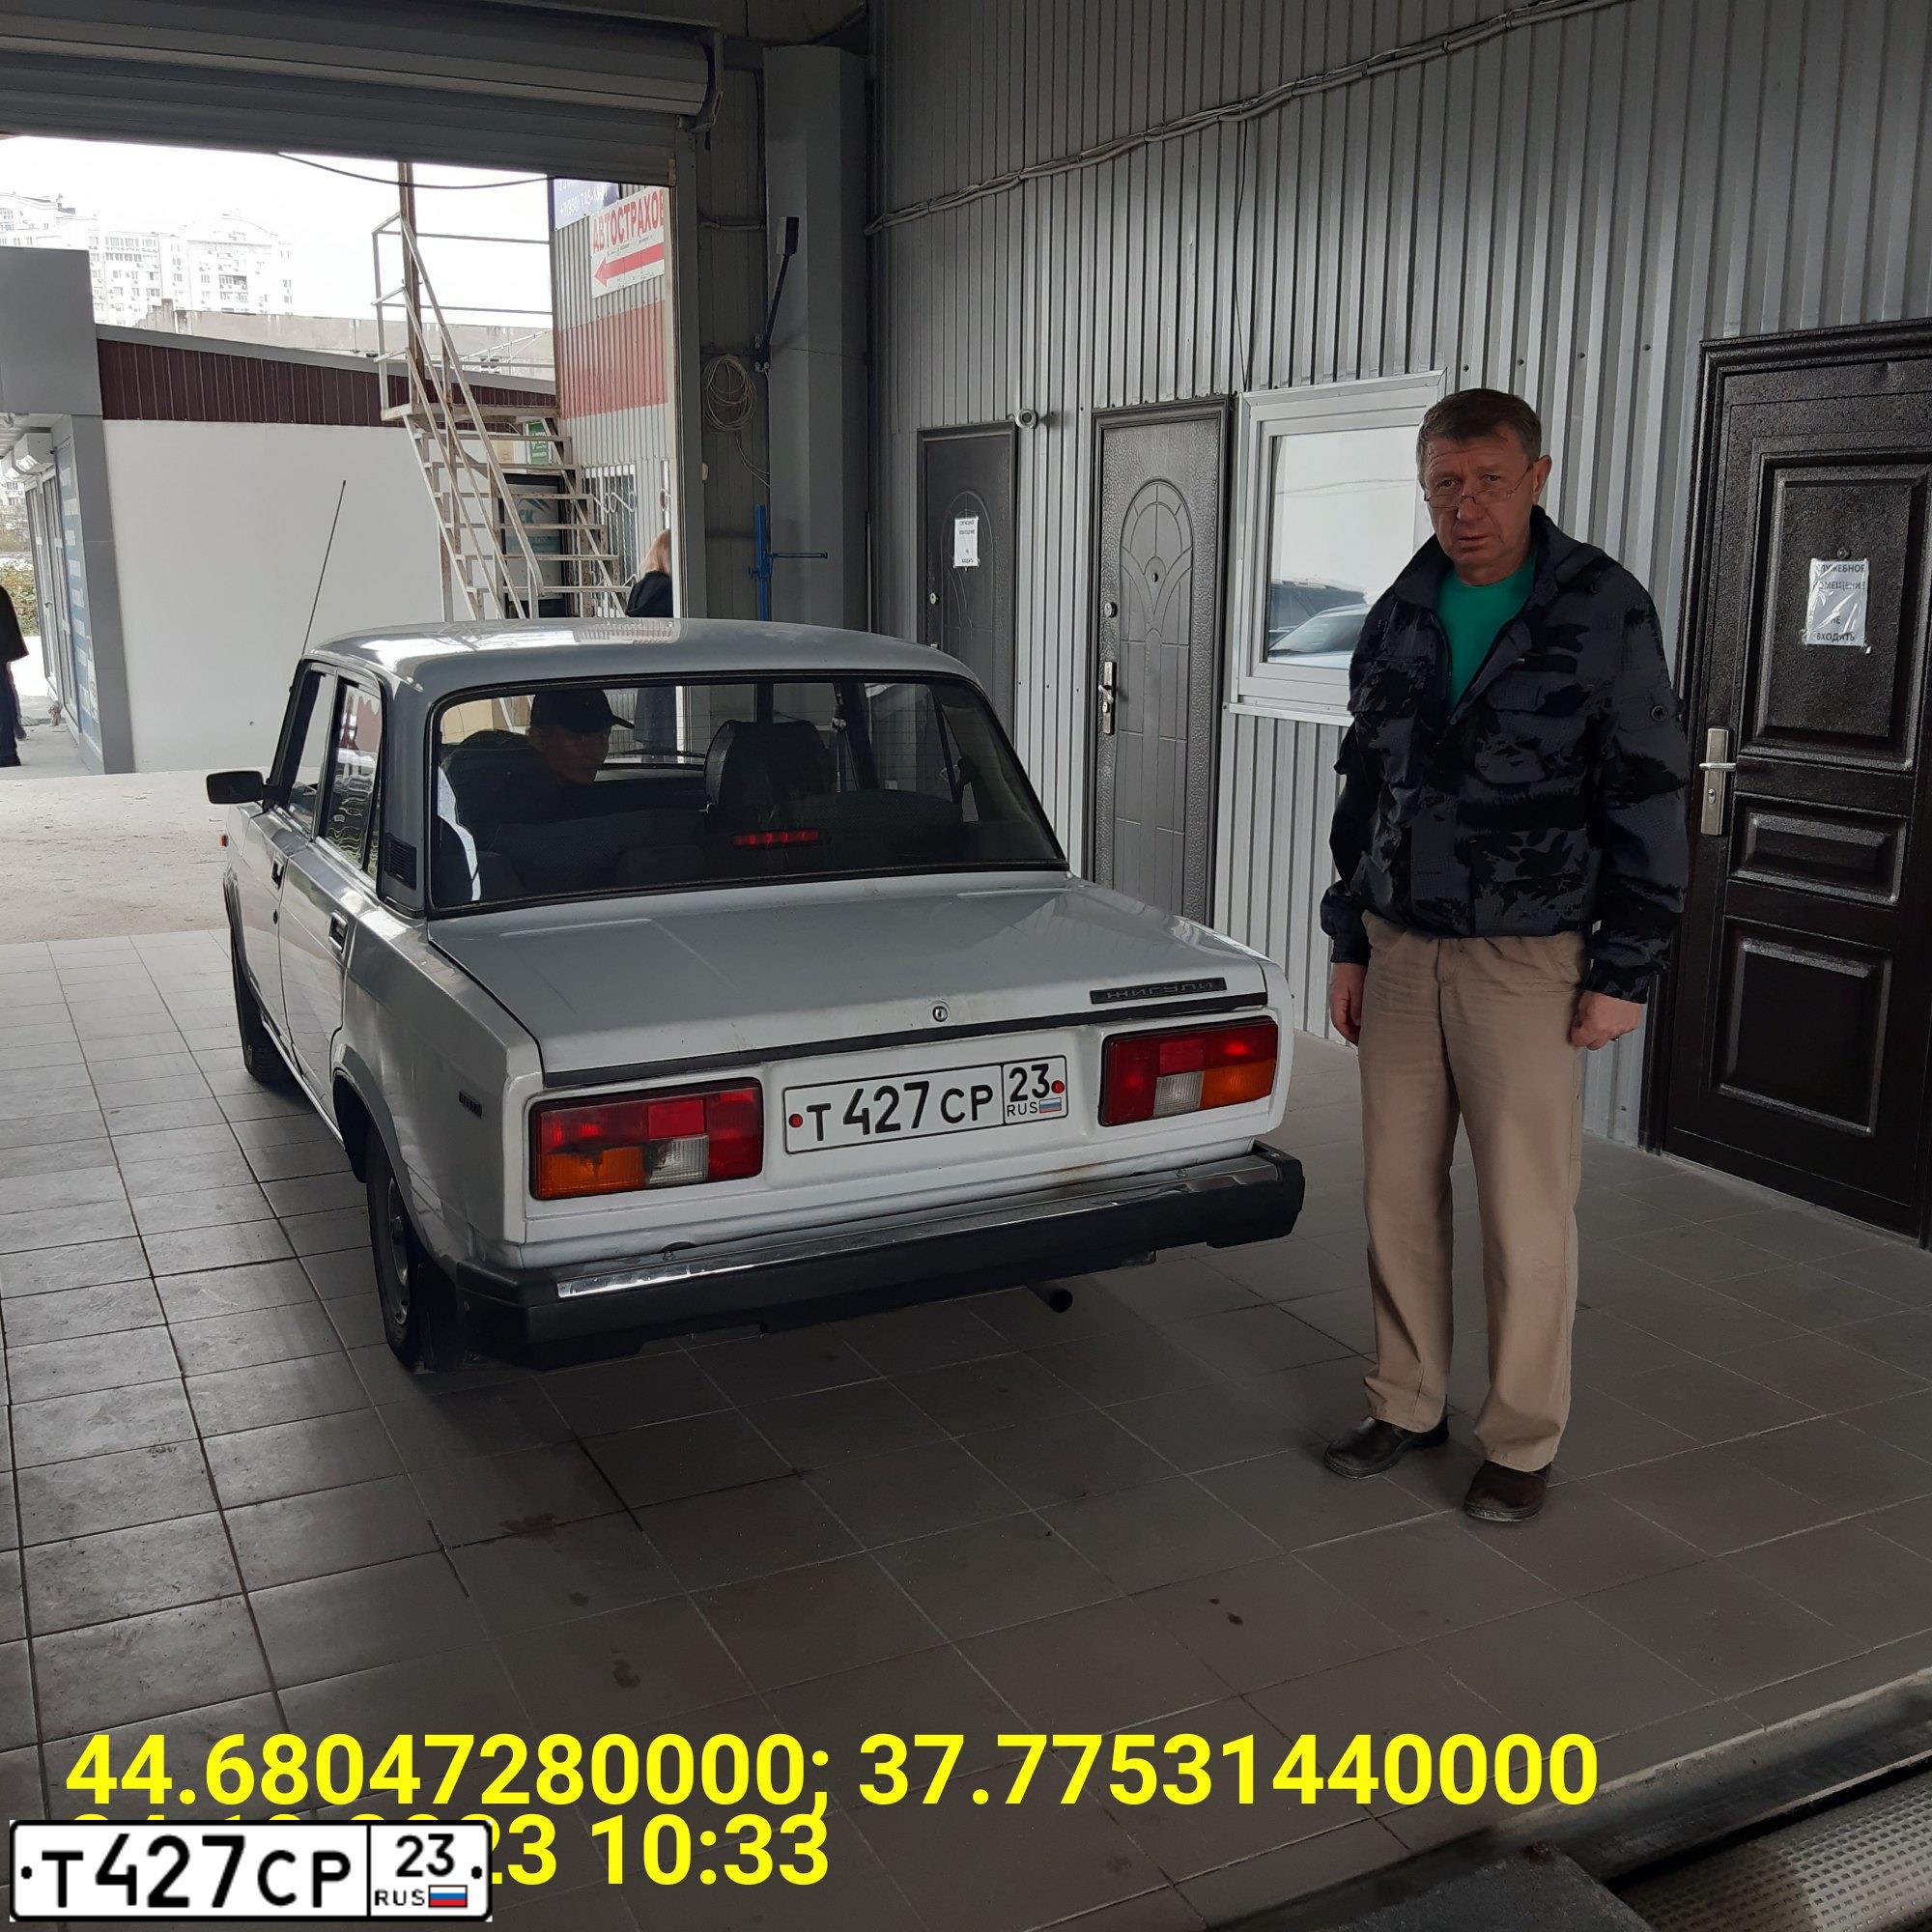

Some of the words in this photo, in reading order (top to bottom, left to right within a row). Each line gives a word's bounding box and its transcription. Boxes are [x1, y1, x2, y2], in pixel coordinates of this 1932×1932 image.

[1818, 564, 1865, 573] ЛУЖЕБНОЕ
[1819, 581, 1866, 591] ОМЕЩЕНИЕ
[1817, 632, 1855, 642] ВХОДИТЬ
[1105, 980, 1213, 1000] ЖИГУЛИ
[1009, 1063, 1051, 1103] 23
[1007, 1101, 1039, 1118] RUS
